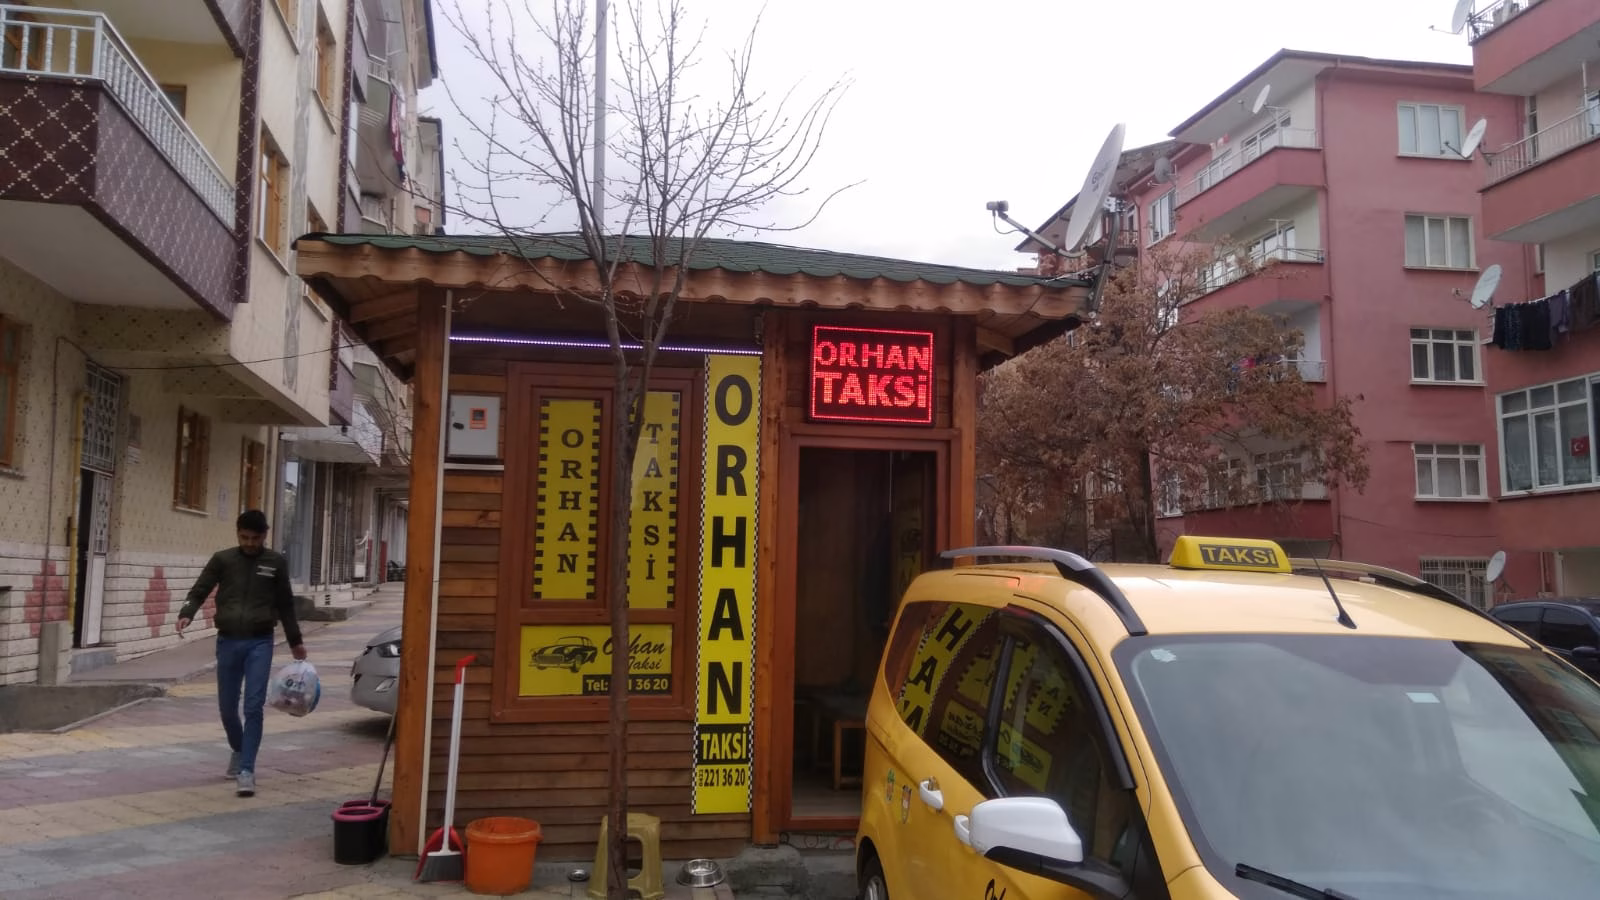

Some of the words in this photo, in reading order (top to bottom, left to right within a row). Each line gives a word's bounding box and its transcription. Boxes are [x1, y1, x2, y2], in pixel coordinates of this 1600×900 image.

[815, 341, 929, 371] ORHAN
[556, 428, 585, 574] ORHAN
[642, 423, 664, 580] TAKSİ
[706, 374, 753, 714] ORHAN
[586, 679, 608, 691] Tel:
[701, 726, 747, 760] TAKSİ
[704, 768, 720, 787] 221
